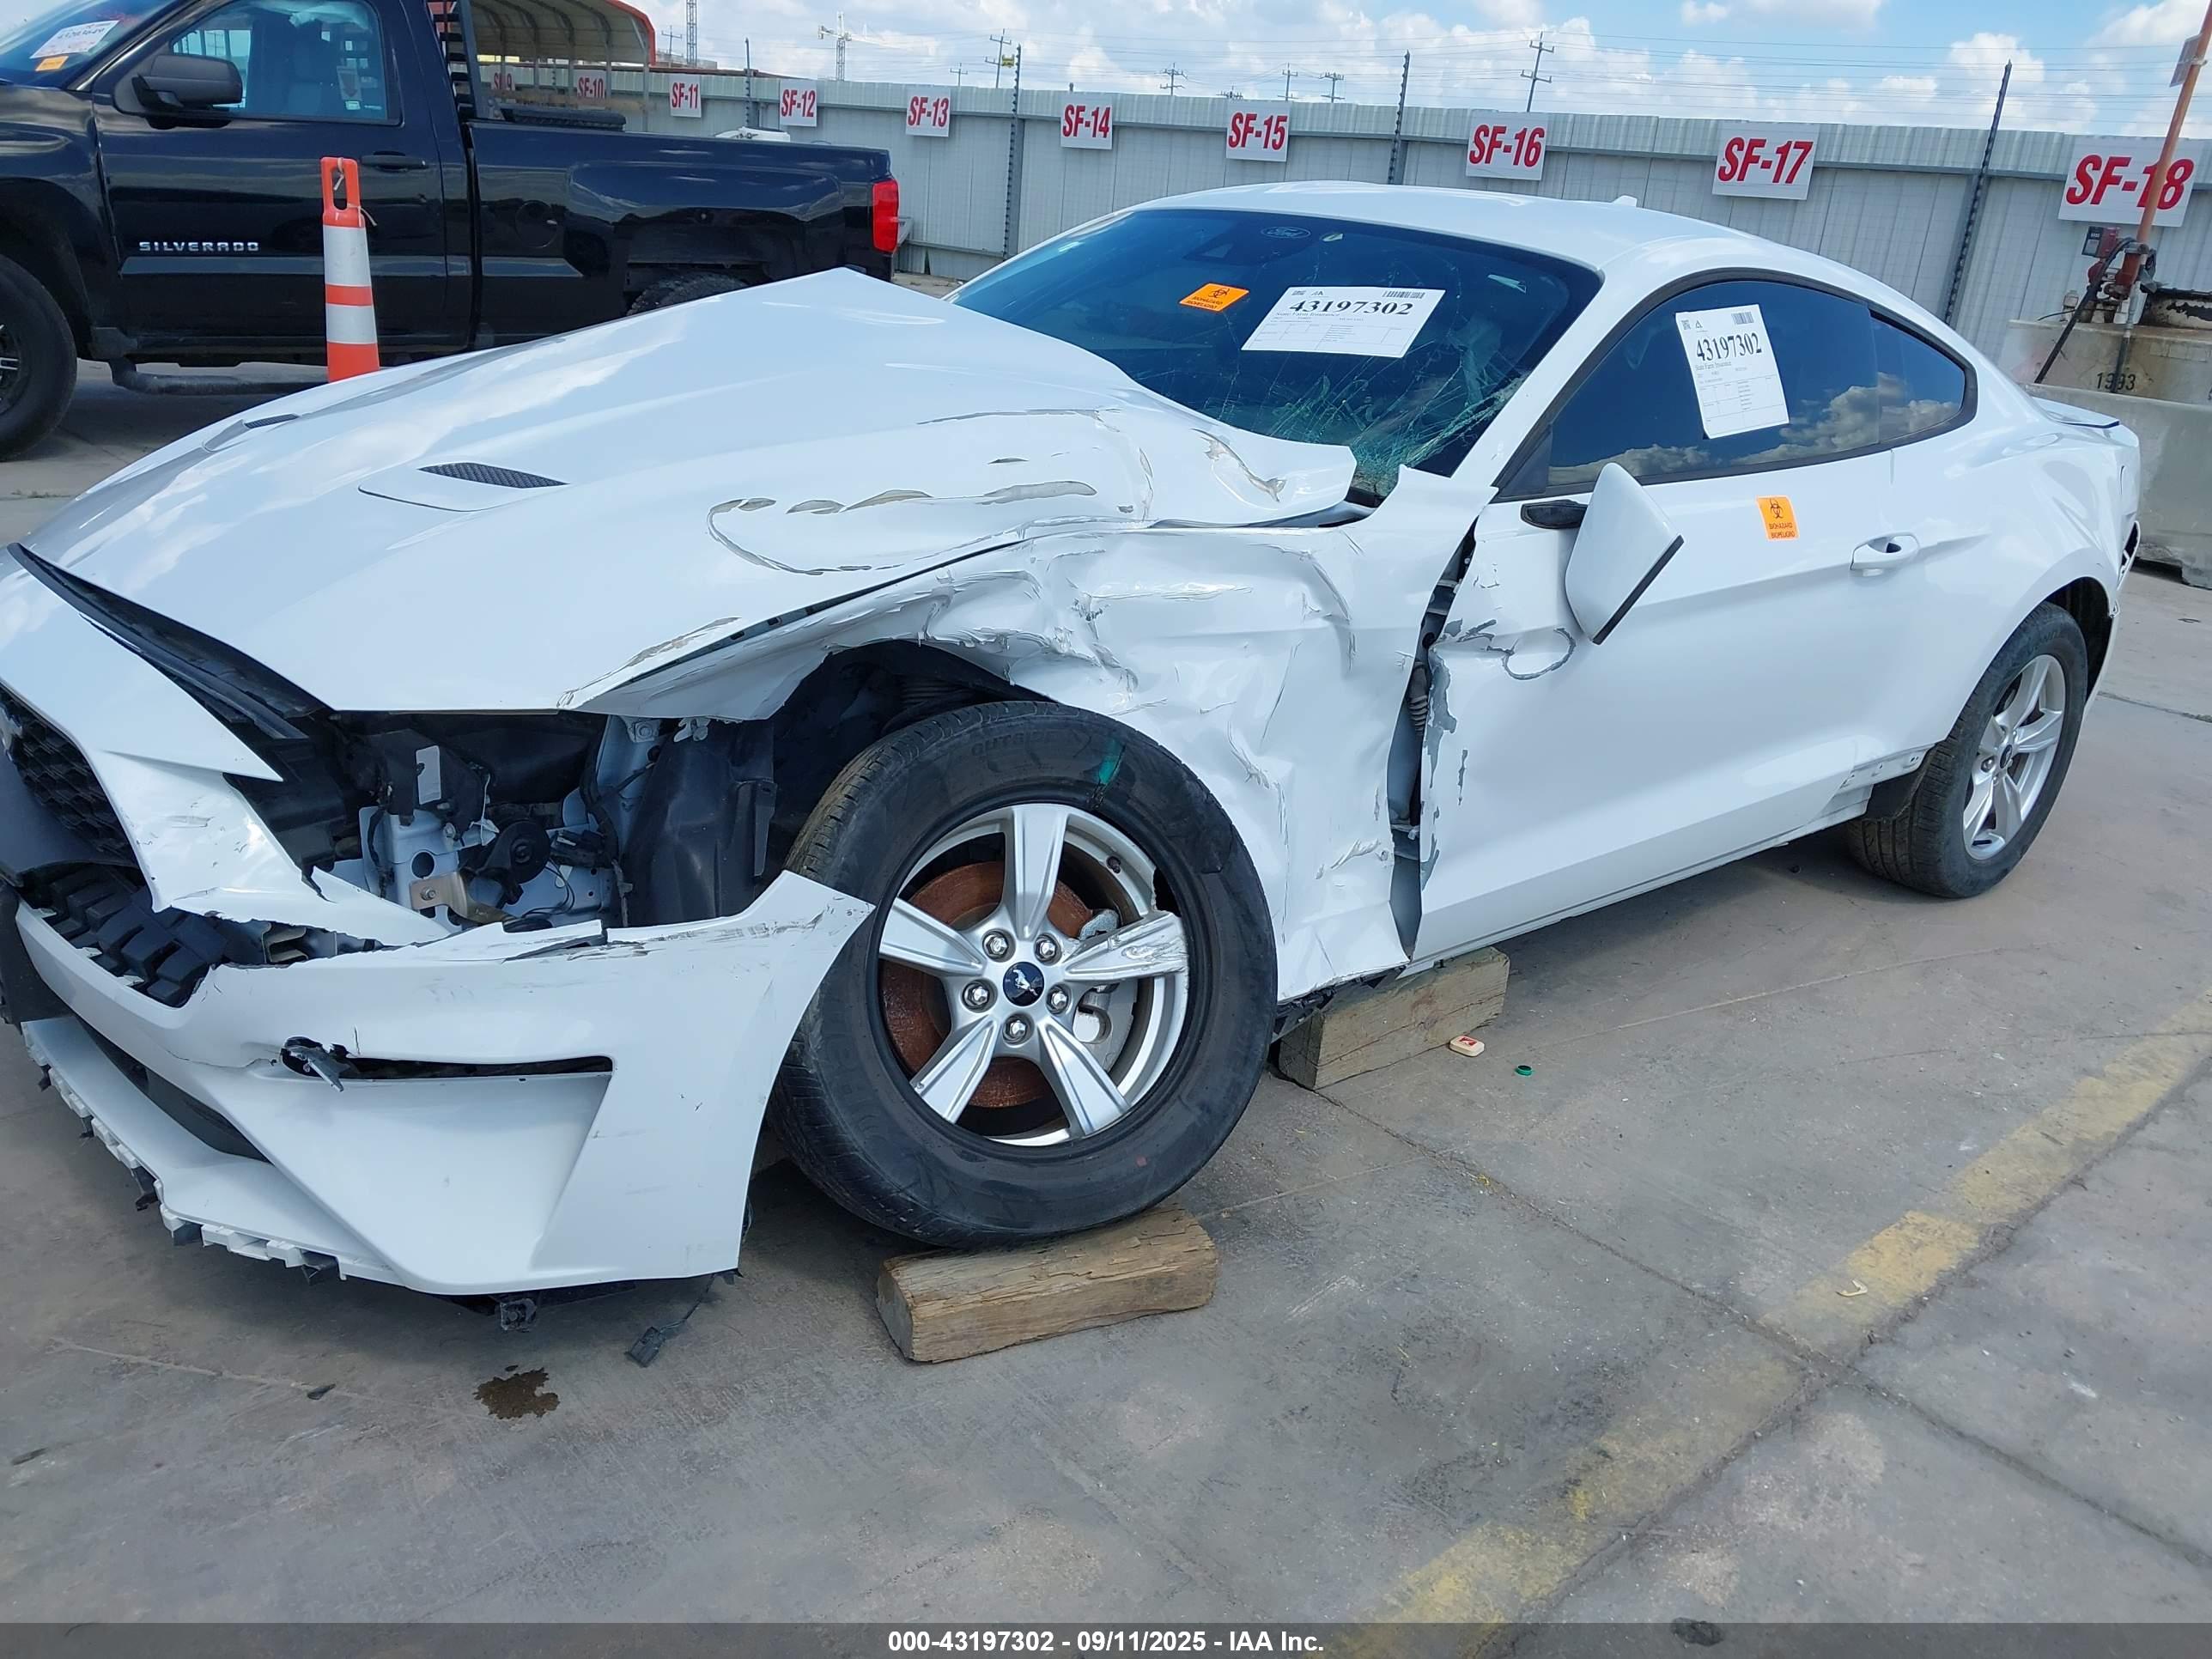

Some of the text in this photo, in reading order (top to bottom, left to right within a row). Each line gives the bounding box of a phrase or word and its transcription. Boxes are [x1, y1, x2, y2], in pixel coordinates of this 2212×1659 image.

[672, 82, 698, 109] SF-11
[781, 89, 816, 117] SF-12
[908, 95, 950, 128] SF-13
[1062, 104, 1111, 138] SF-14
[1228, 112, 1288, 151] SF-15
[1468, 124, 1546, 167] SF-16
[1718, 137, 1814, 184] SF-17
[2066, 154, 2195, 210] SF-18
[139, 241, 259, 252] SILVERADO
[1289, 300, 1414, 316] 43197302
[1696, 332, 1762, 362] 43197302
